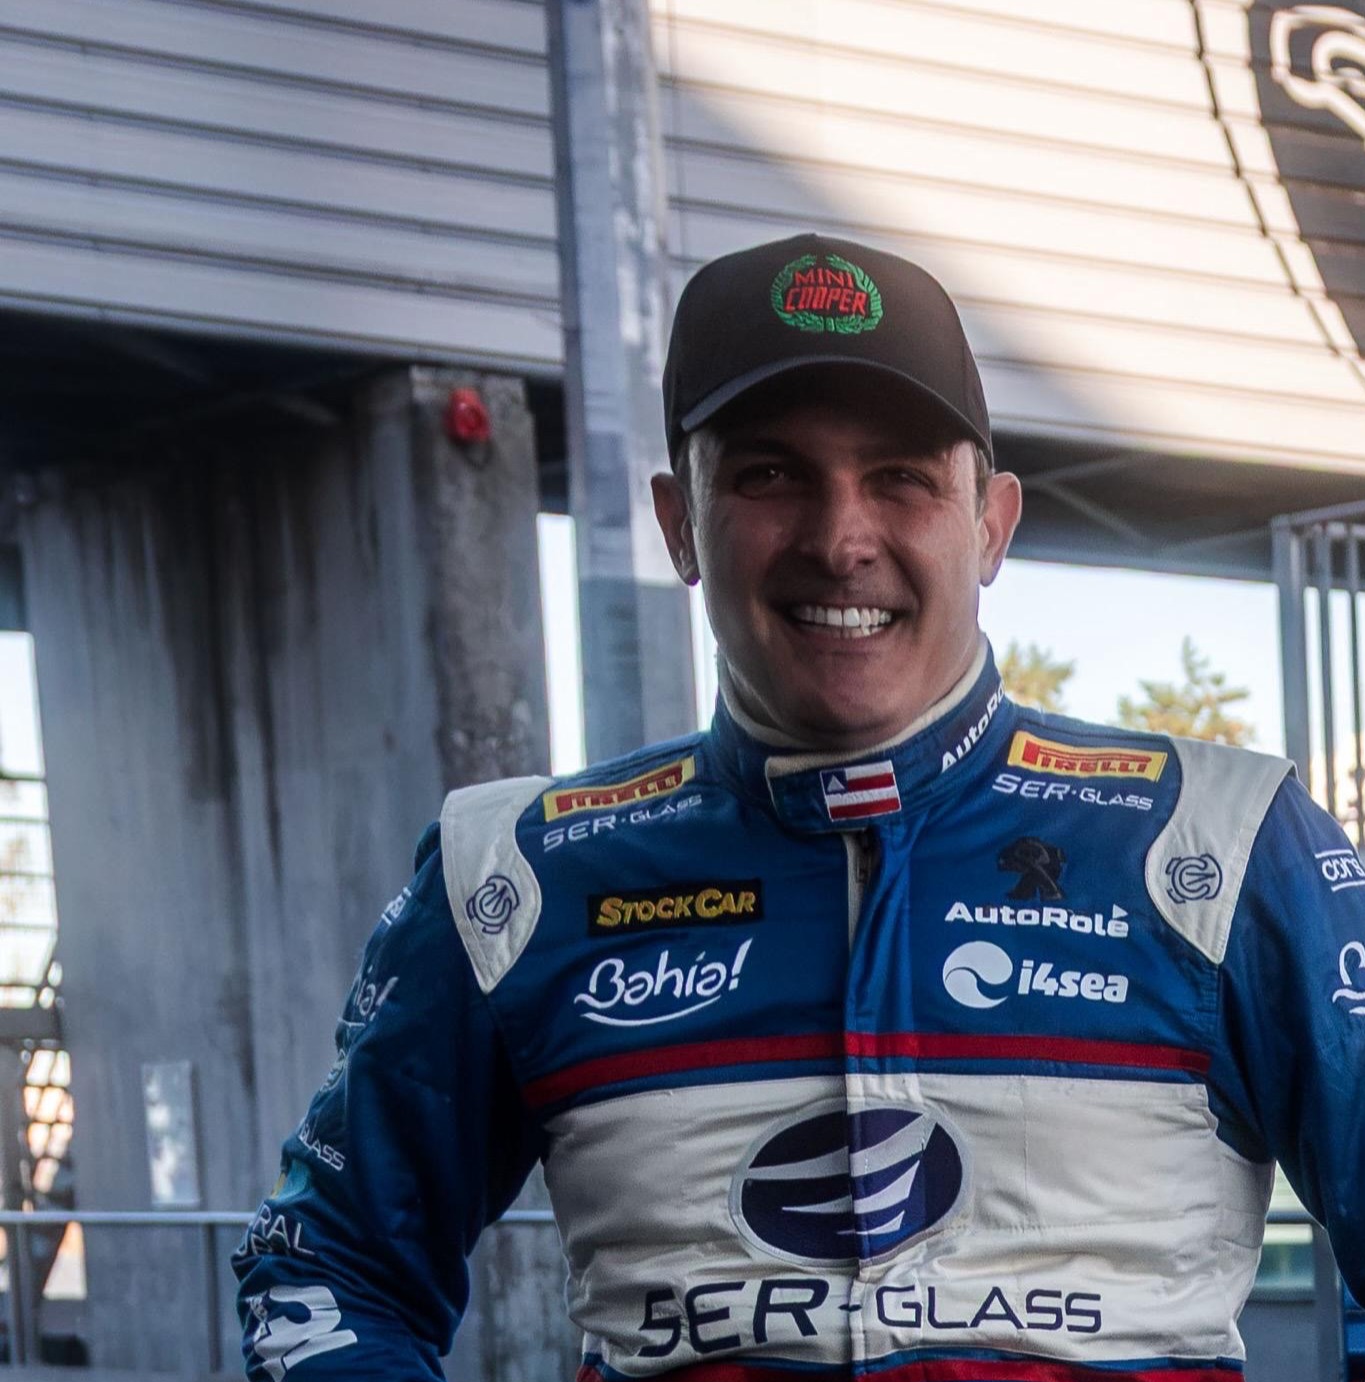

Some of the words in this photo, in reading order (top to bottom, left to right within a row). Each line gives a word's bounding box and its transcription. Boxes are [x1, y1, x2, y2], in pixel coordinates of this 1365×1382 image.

[795, 267, 854, 289] MINI
[784, 286, 868, 316] COOPER
[1017, 959, 1129, 1003] i4sea
